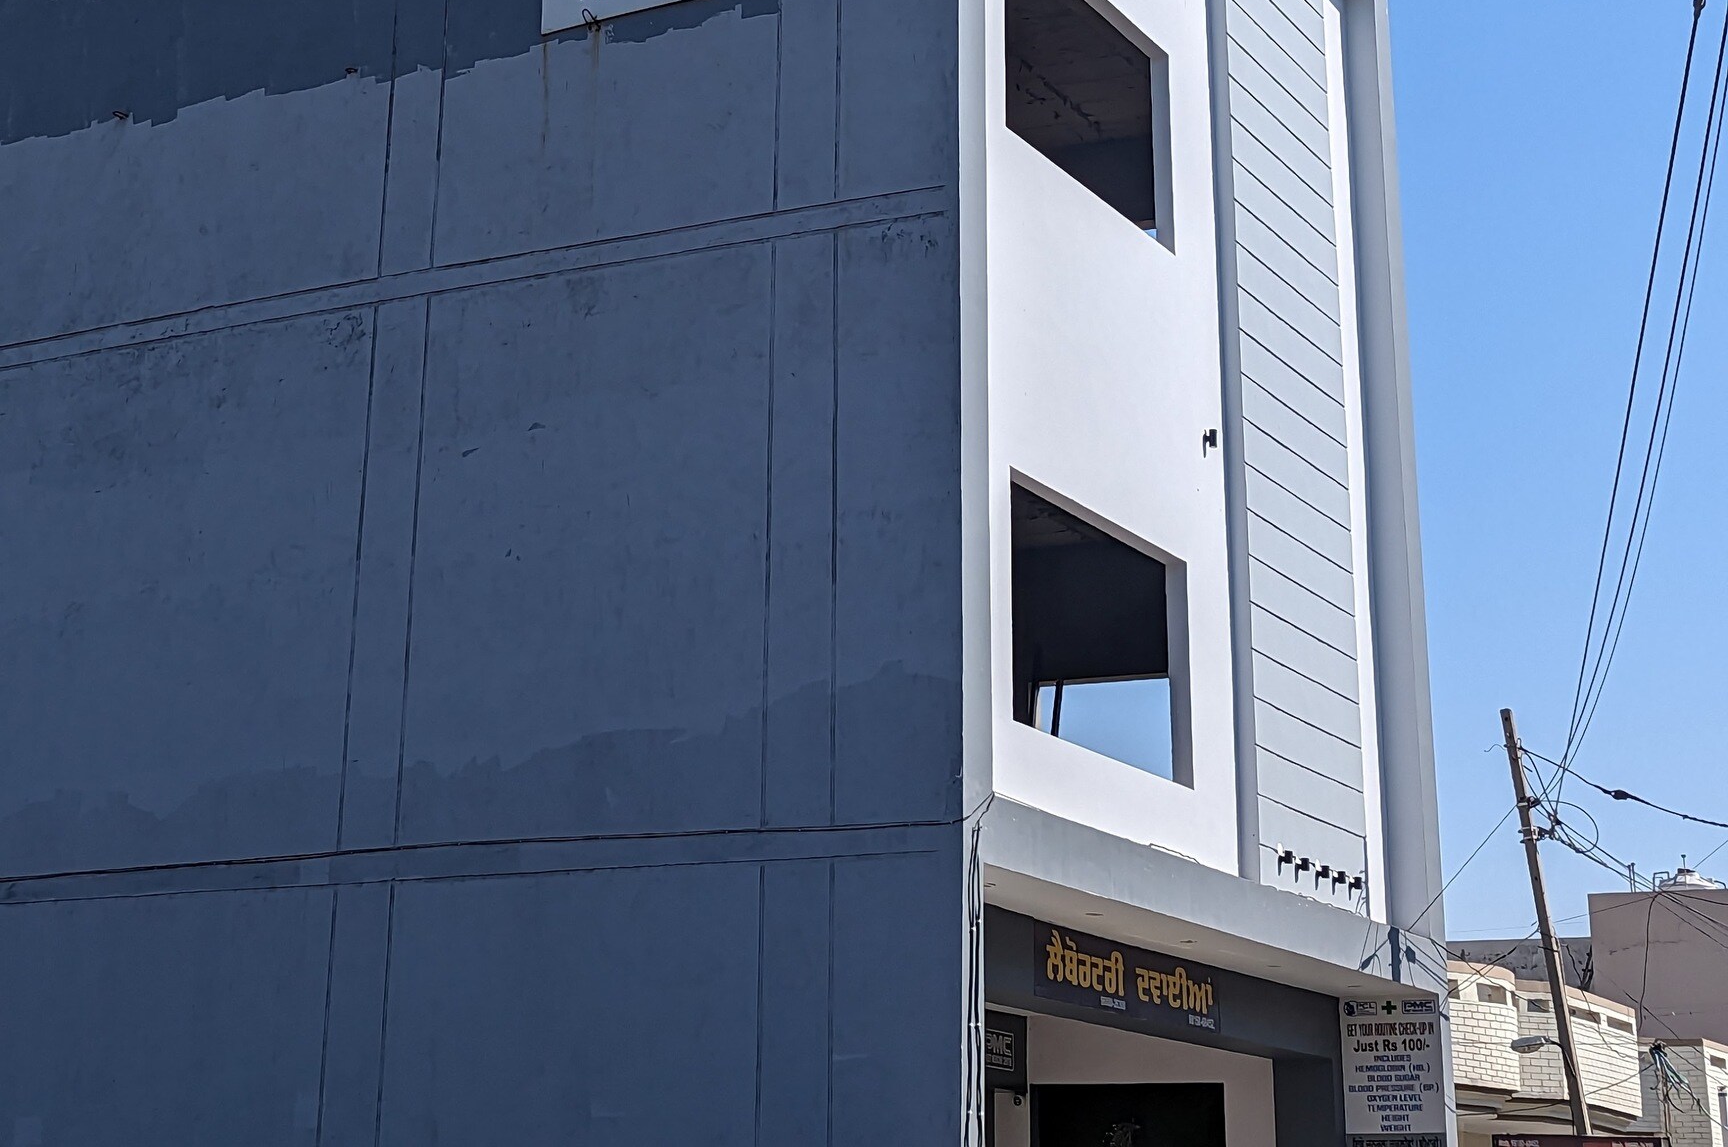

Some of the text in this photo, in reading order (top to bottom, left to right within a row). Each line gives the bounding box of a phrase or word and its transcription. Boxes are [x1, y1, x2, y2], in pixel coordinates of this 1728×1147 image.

[1135, 966, 1214, 1015] ਦਵਾਈਆਂ
[1347, 1021, 1435, 1037] GET YOUR ROUTINE CHECK-UP IN
[1353, 1038, 1430, 1053] Just Rs 100/-
[1373, 1054, 1412, 1062] INCLUDES
[1355, 1064, 1406, 1073] HEMOGLOBIN
[1367, 1074, 1421, 1082] BLOOD SUGAR
[1348, 1084, 1374, 1093] BLOOD
[1375, 1083, 1415, 1092] PRESSURE
[1366, 1094, 1422, 1102] OXYGEN LEVEL
[1367, 1104, 1423, 1112] TEMPERATURE
[1381, 1114, 1410, 1122] HEIGHT
[1380, 1124, 1412, 1132] WEIGHT
